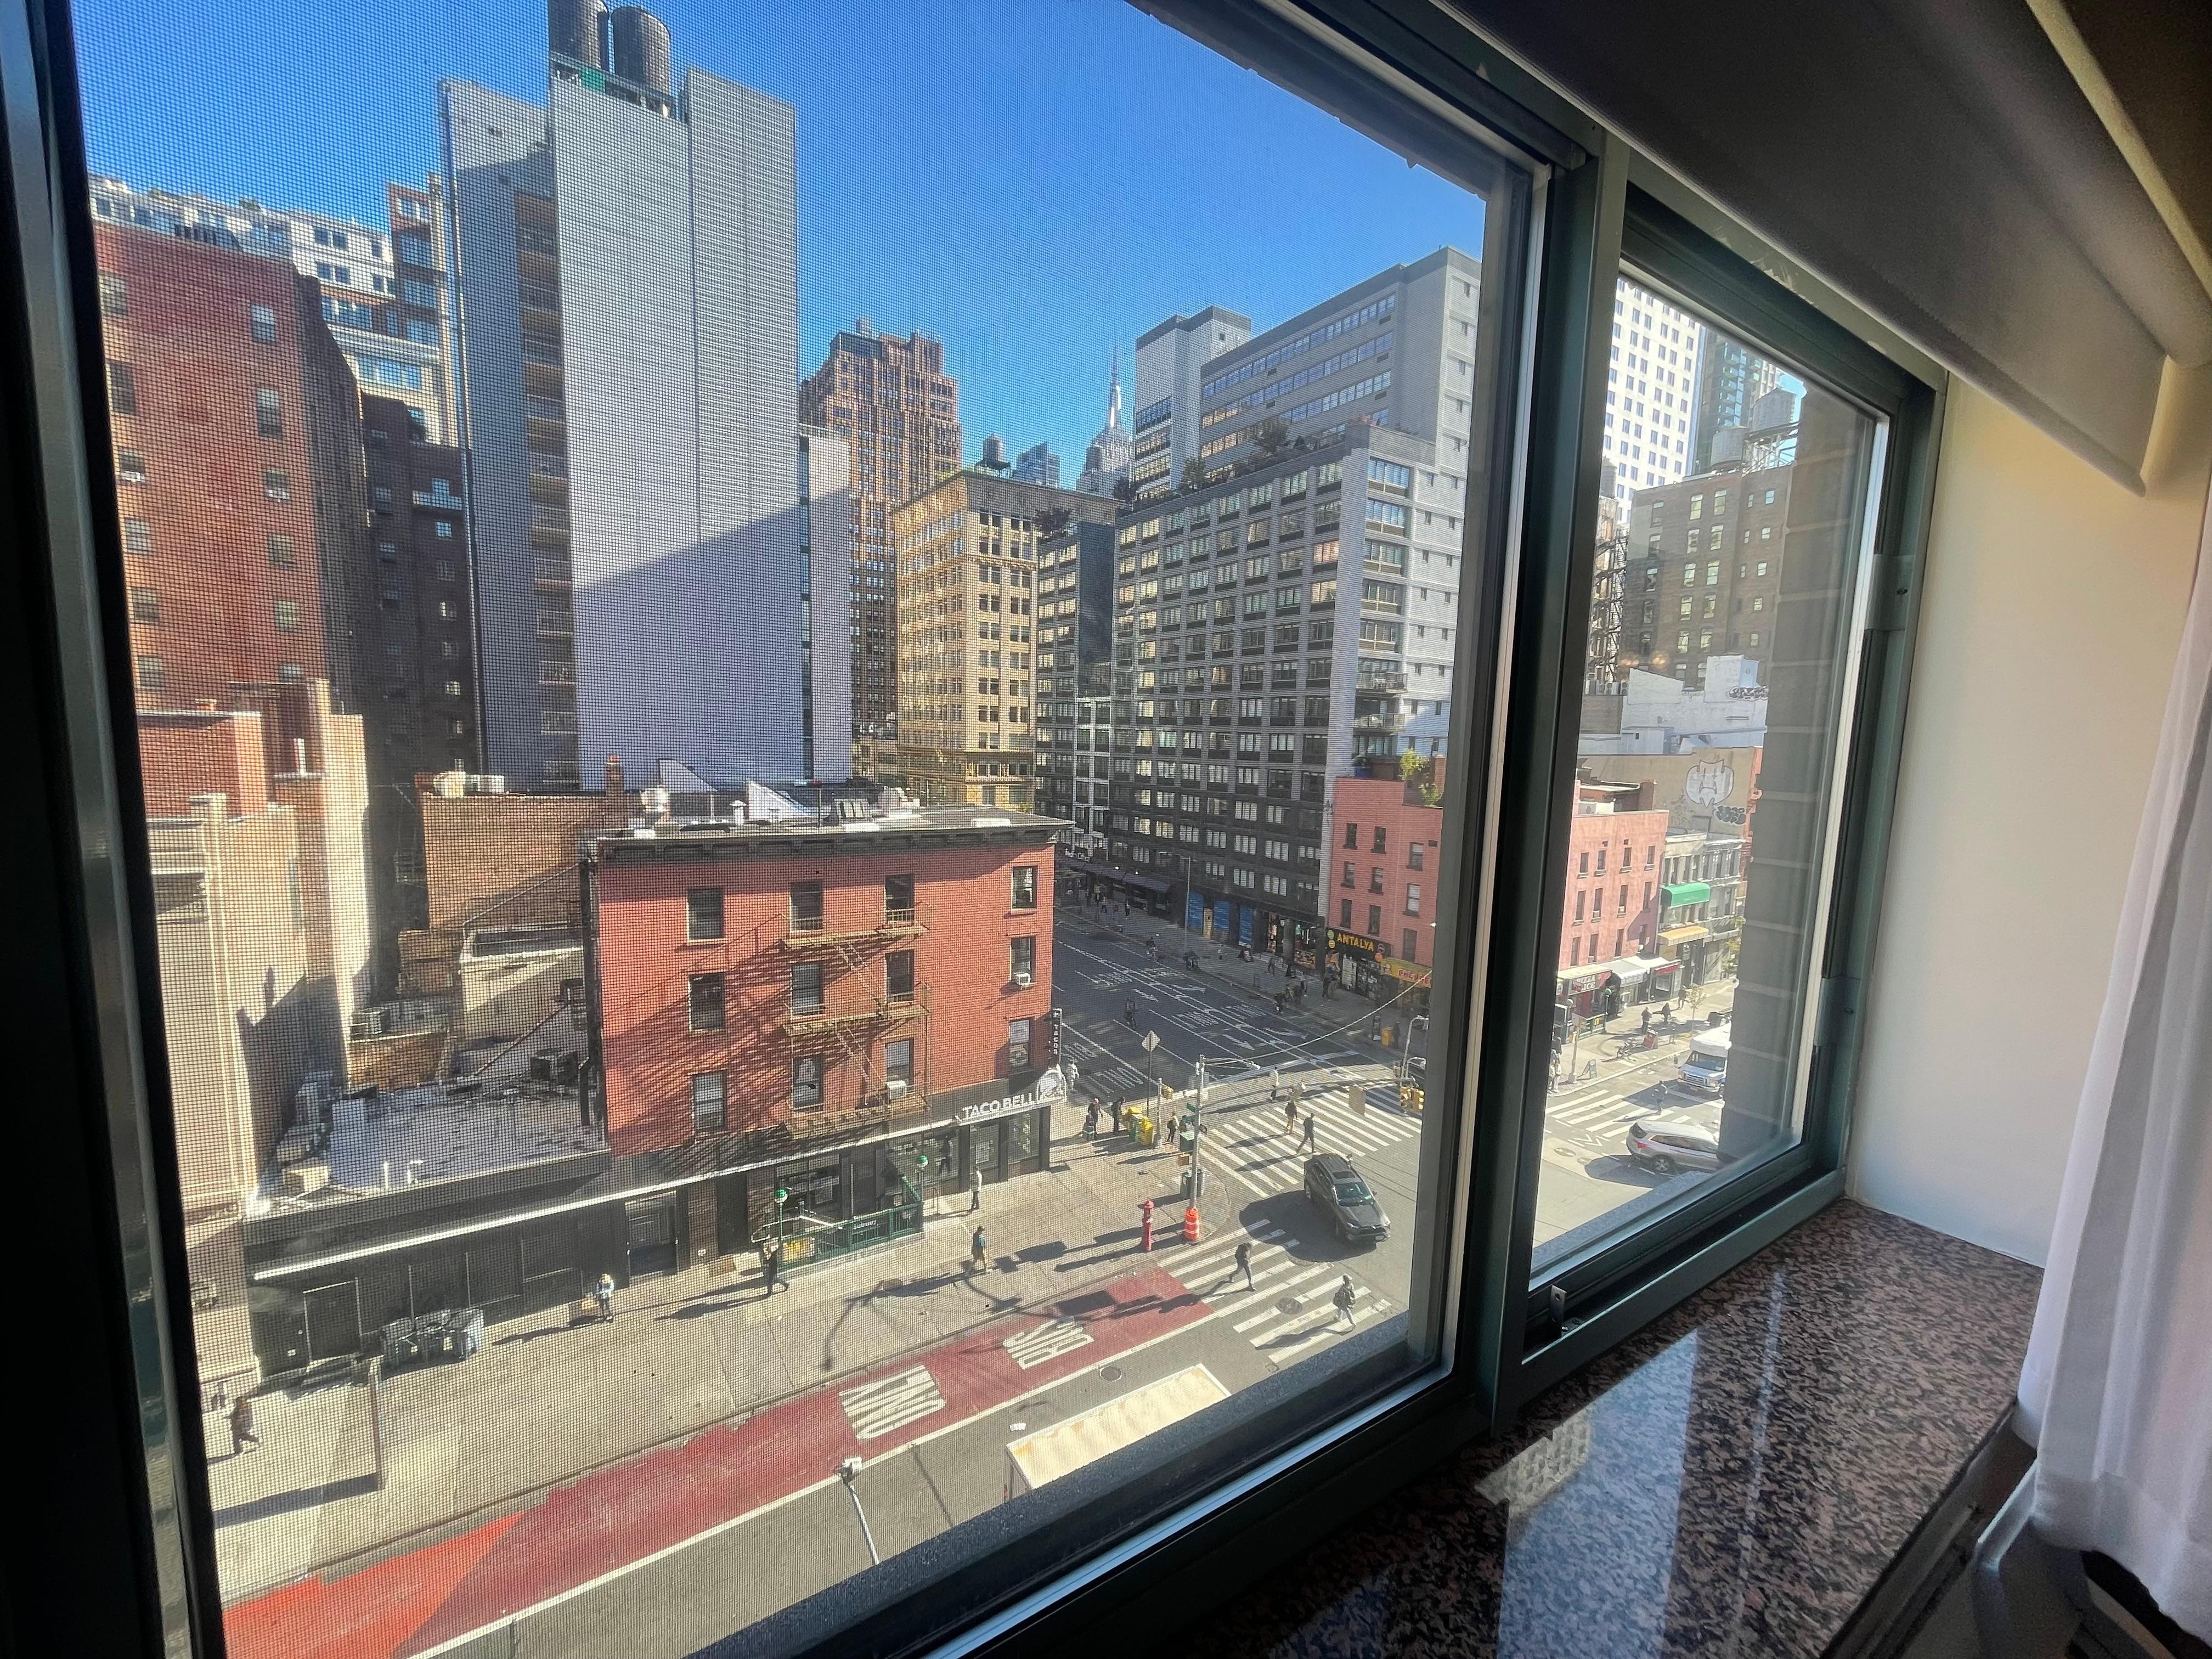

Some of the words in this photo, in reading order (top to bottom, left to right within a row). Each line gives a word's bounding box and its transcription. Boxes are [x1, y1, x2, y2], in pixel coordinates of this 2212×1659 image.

[1337, 933, 1374, 951] ANTALYA
[962, 1099, 1001, 1118] TACO
[1002, 1092, 1036, 1110] BELL
[1003, 1316, 1094, 1370] BUS
[839, 1364, 946, 1441] ONLY
